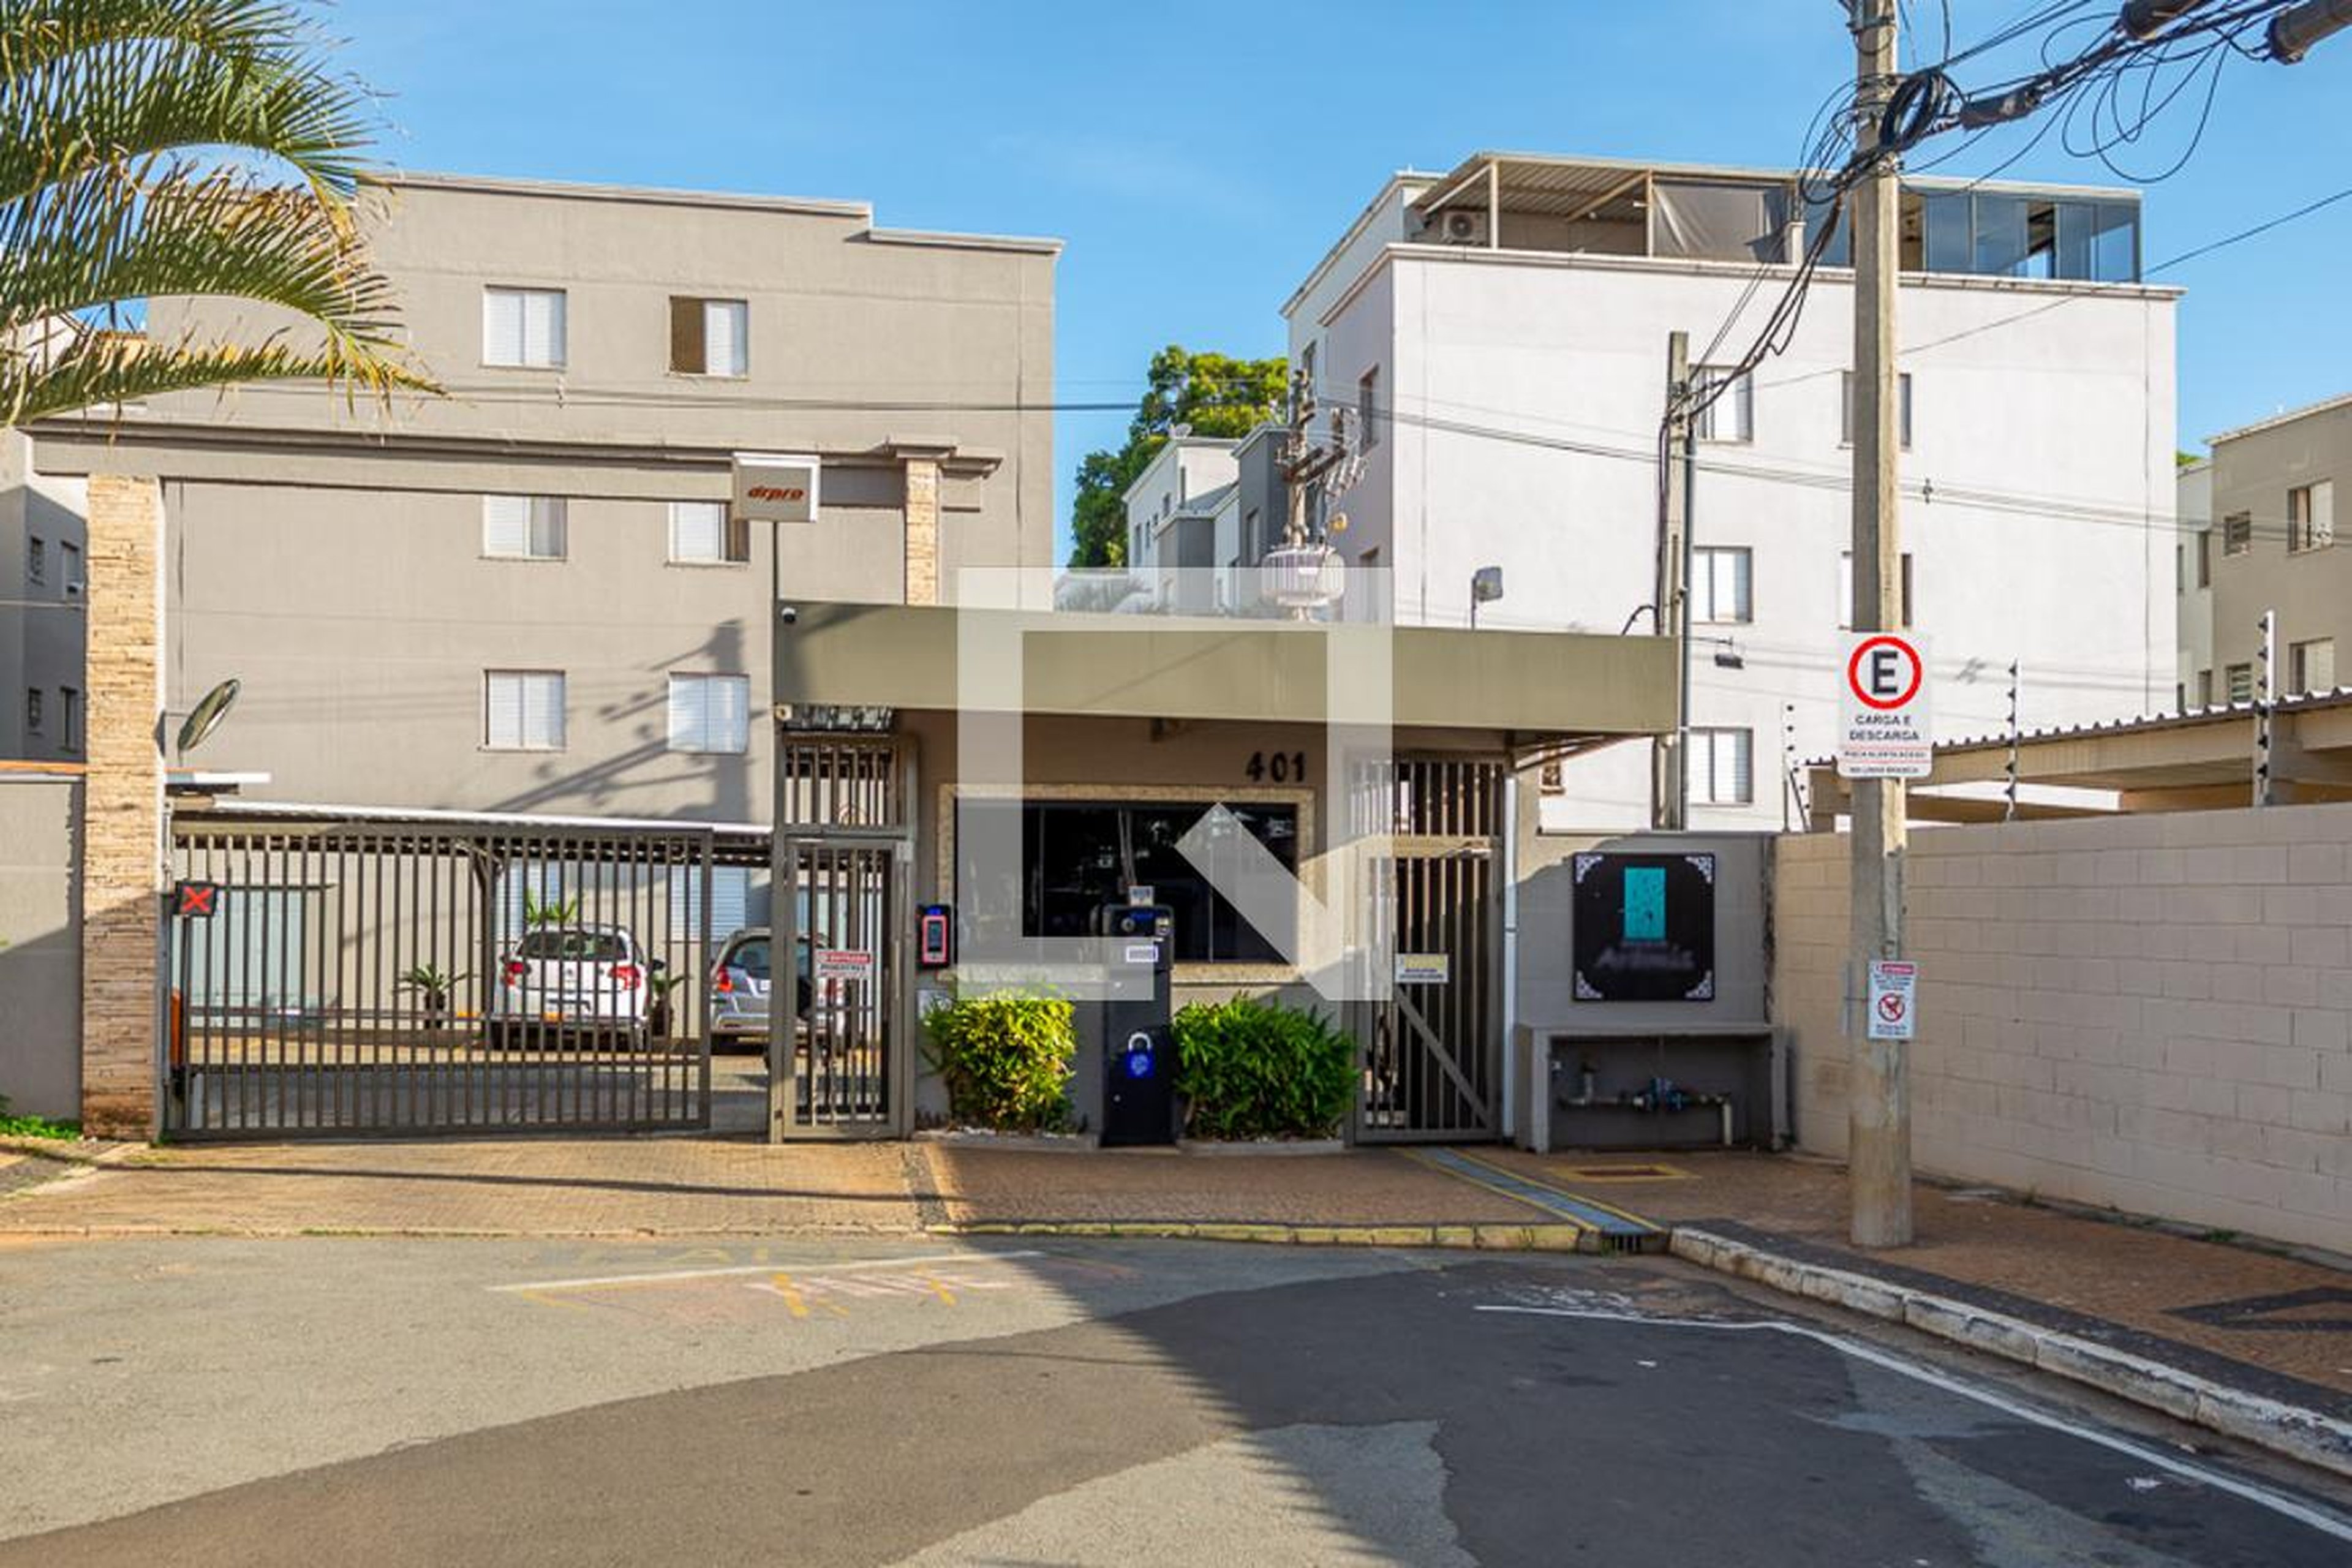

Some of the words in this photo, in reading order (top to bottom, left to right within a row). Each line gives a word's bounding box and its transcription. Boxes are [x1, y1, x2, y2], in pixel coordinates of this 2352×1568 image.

[1872, 651, 1898, 694] E
[1855, 715, 1900, 725] CARGA
[1903, 715, 1911, 725] E
[1849, 730, 1919, 741] DESCARGA
[1245, 751, 1305, 783] 401
